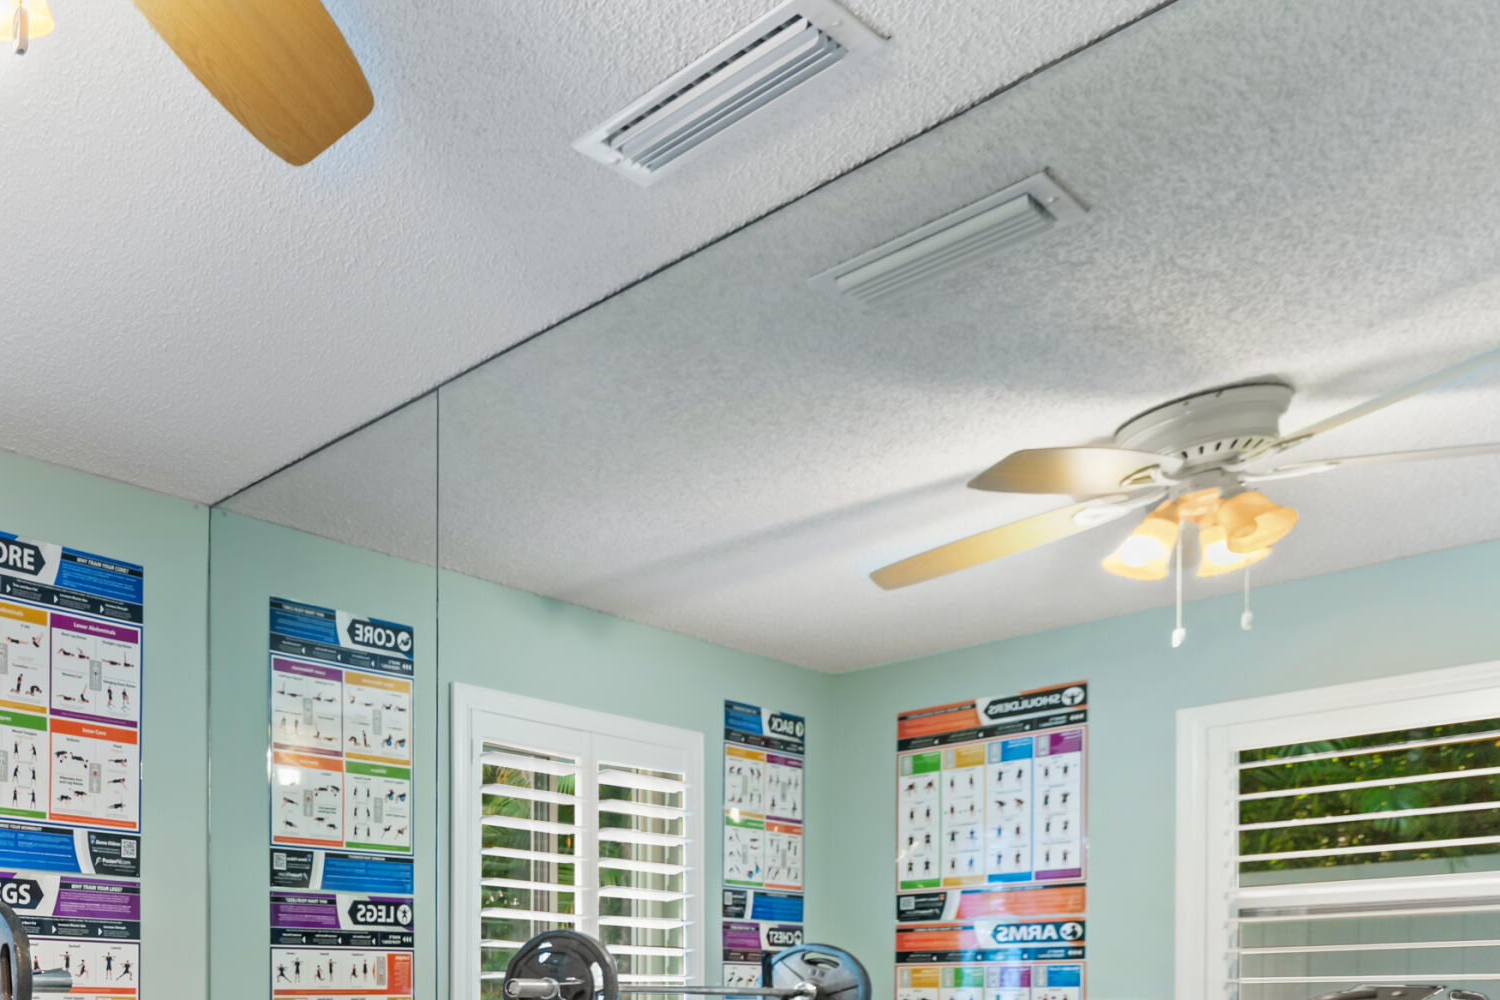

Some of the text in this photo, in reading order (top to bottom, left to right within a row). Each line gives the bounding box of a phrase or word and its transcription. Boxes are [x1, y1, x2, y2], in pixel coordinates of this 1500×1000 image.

[88, 559, 101, 567] TRAIN
[102, 562, 115, 570] YOUR
[115, 565, 129, 573] CORE?
[73, 622, 116, 636] Lower Abdominals
